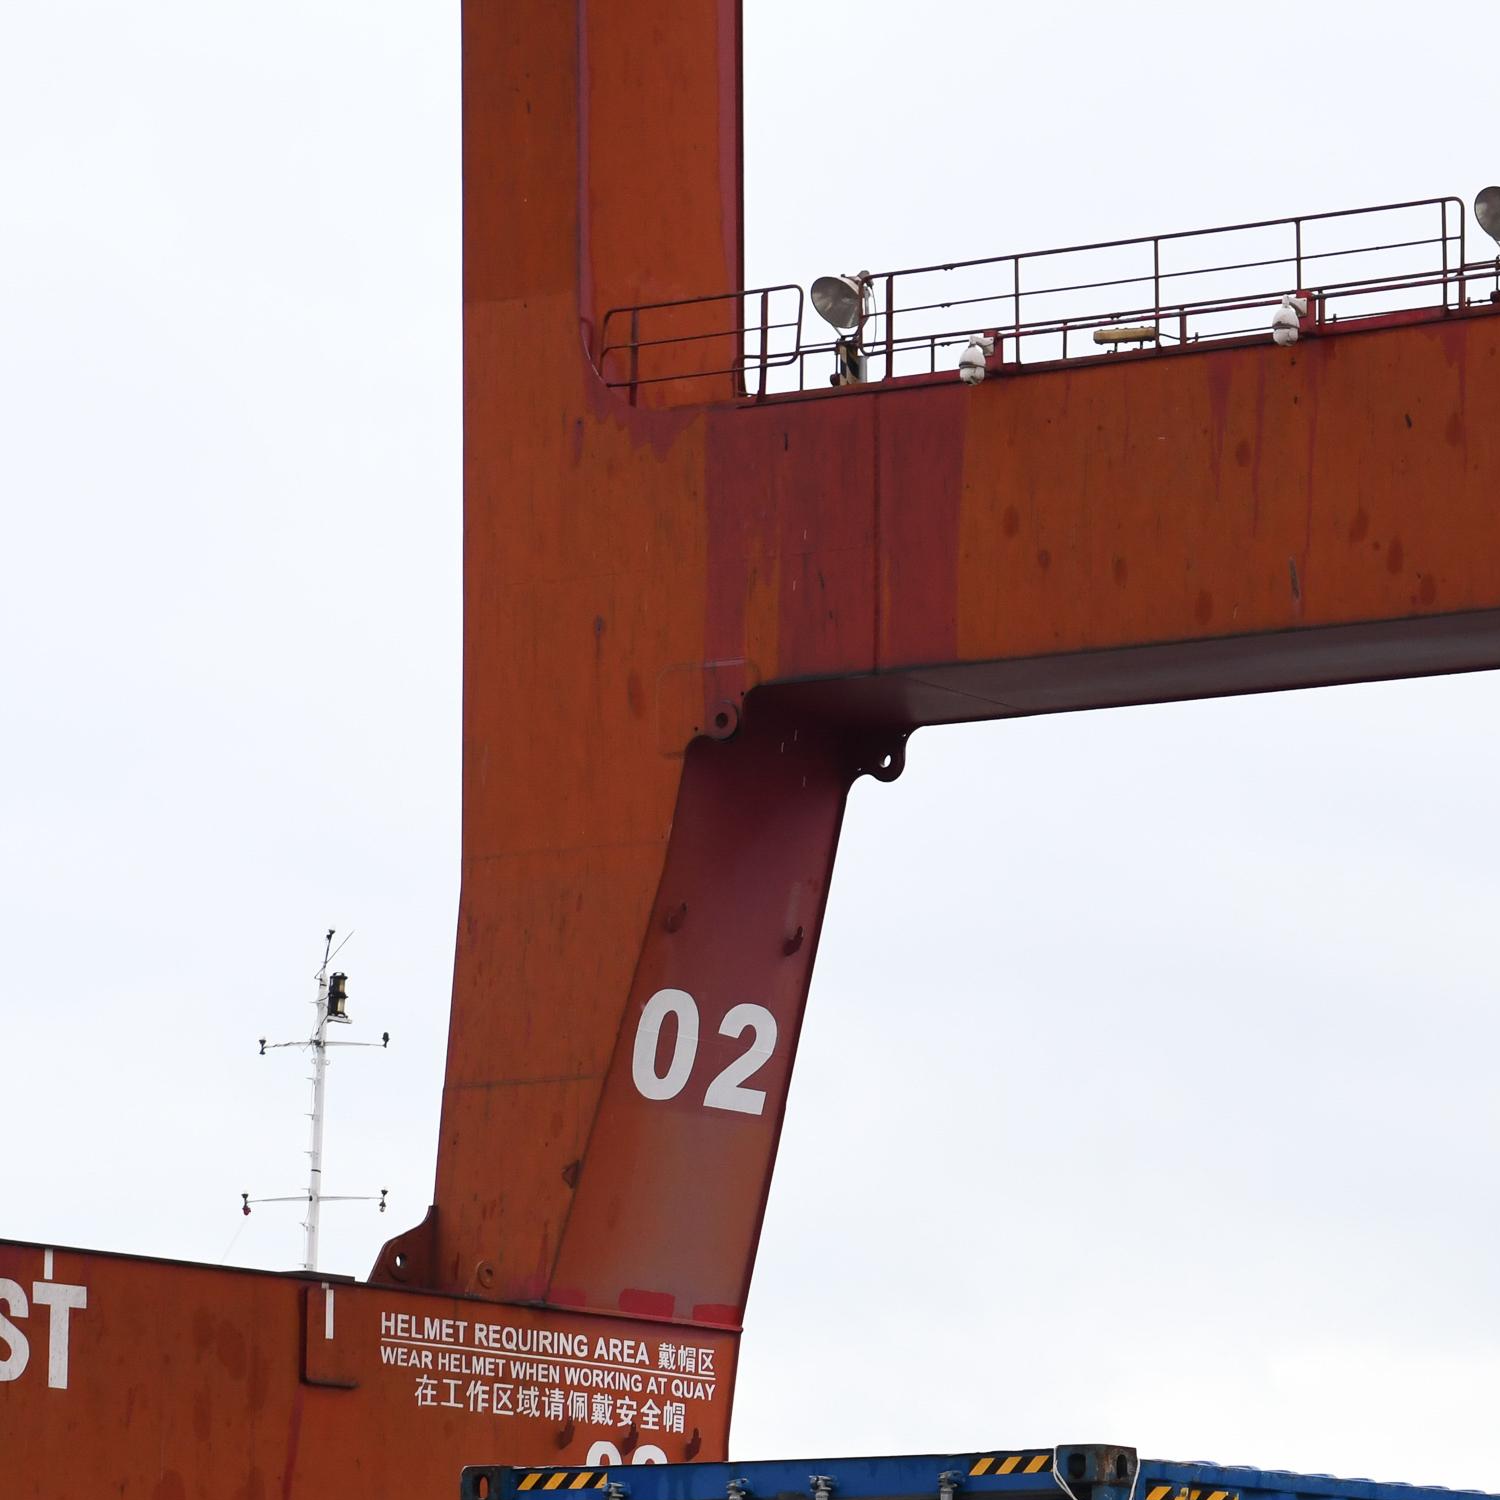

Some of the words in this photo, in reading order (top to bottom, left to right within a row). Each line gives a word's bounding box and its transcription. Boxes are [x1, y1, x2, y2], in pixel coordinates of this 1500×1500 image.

[631, 988, 778, 1116] 02
[380, 1346, 433, 1370] WEAR
[438, 1353, 506, 1378] HELMET
[510, 1361, 560, 1384] WHEN
[564, 1367, 643, 1393] WORKING
[646, 1377, 668, 1395] AT
[671, 1378, 716, 1401] QUAY
[381, 1311, 468, 1343] HELMET
[474, 1323, 588, 1358] REQUIRING
[593, 1337, 650, 1365] AREA
[658, 1342, 715, 1376] 戴帽区
[414, 1373, 685, 1433] 在工作区域请佩戴安全帽
